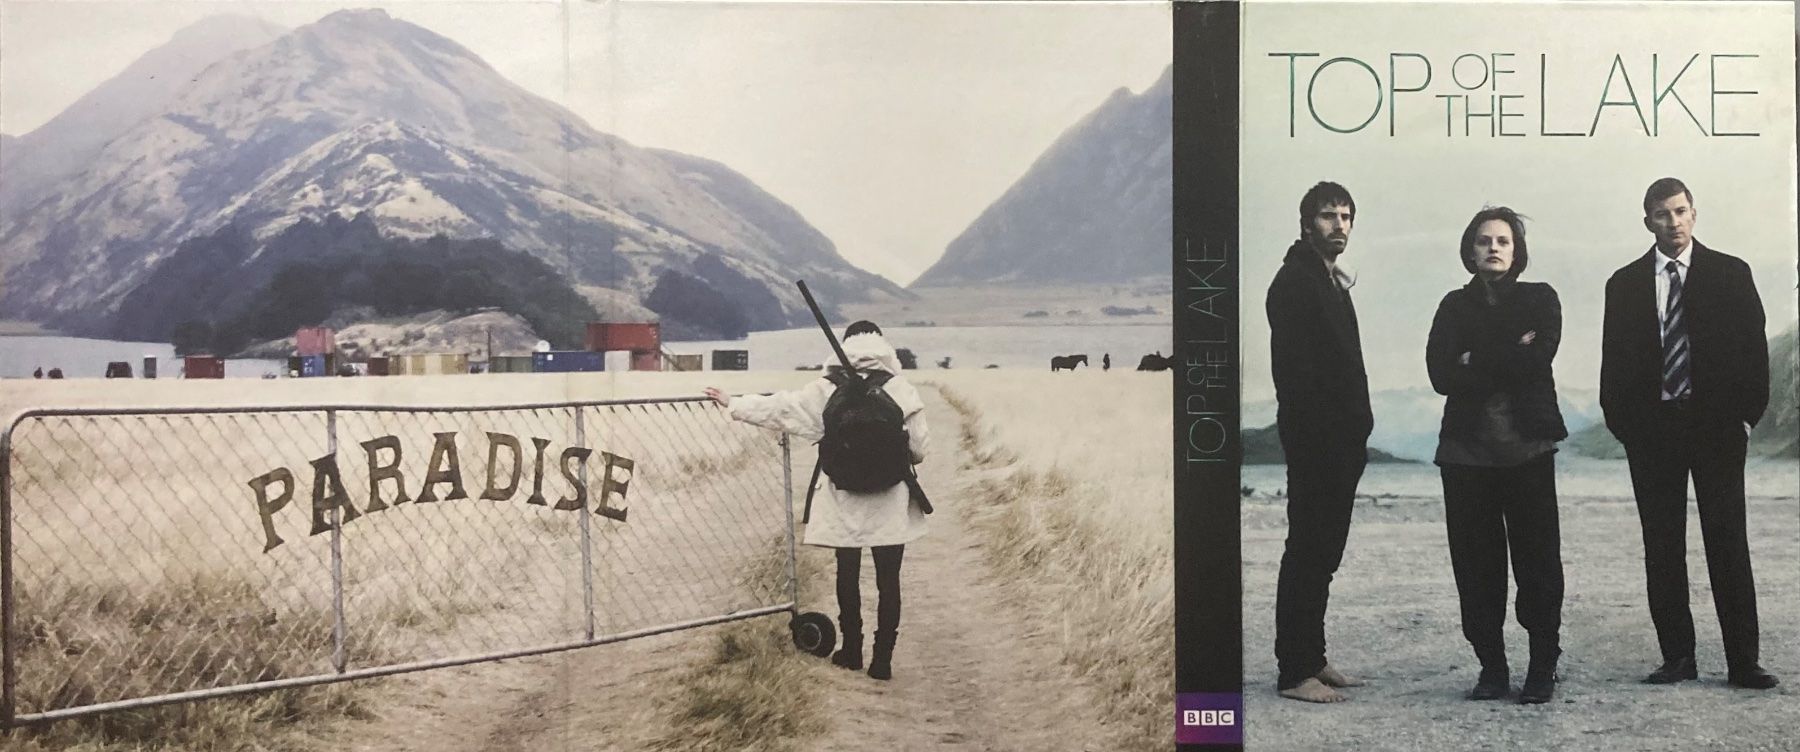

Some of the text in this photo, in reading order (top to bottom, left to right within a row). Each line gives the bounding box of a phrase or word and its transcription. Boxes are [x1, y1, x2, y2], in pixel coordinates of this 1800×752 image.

[1268, 53, 1761, 137] TOP OF THE LAKE
[1186, 237, 1228, 471] TOP OF THE LAKE
[247, 431, 635, 554] PARADISE
[1186, 711, 1233, 724] BBC
